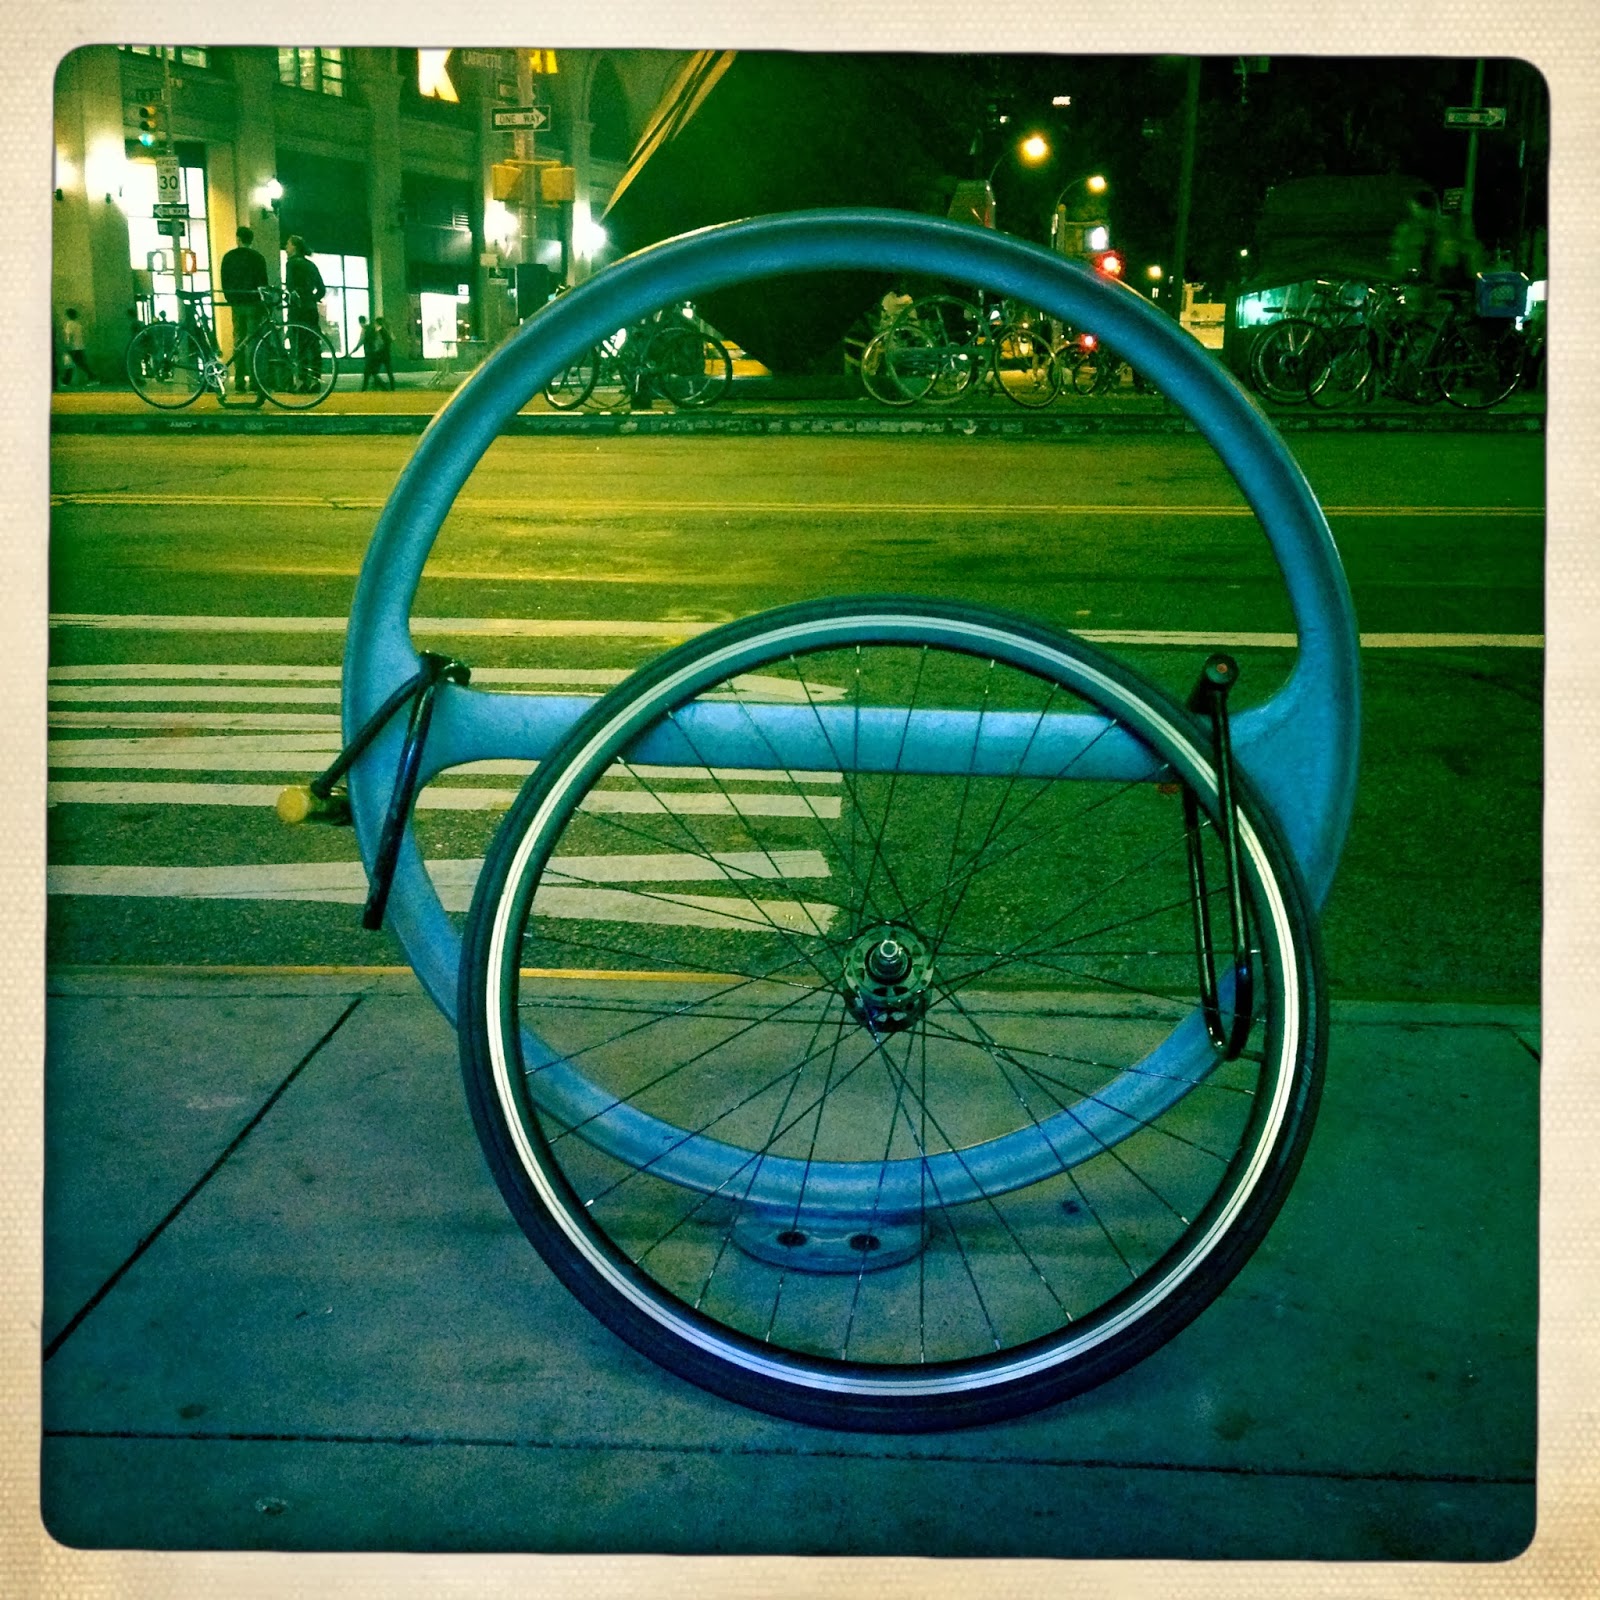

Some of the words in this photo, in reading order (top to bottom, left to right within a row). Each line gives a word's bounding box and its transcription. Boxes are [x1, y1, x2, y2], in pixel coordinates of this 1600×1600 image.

[499, 114, 517, 124] ONE
[524, 112, 541, 123] WAY
[160, 175, 178, 190] 30
